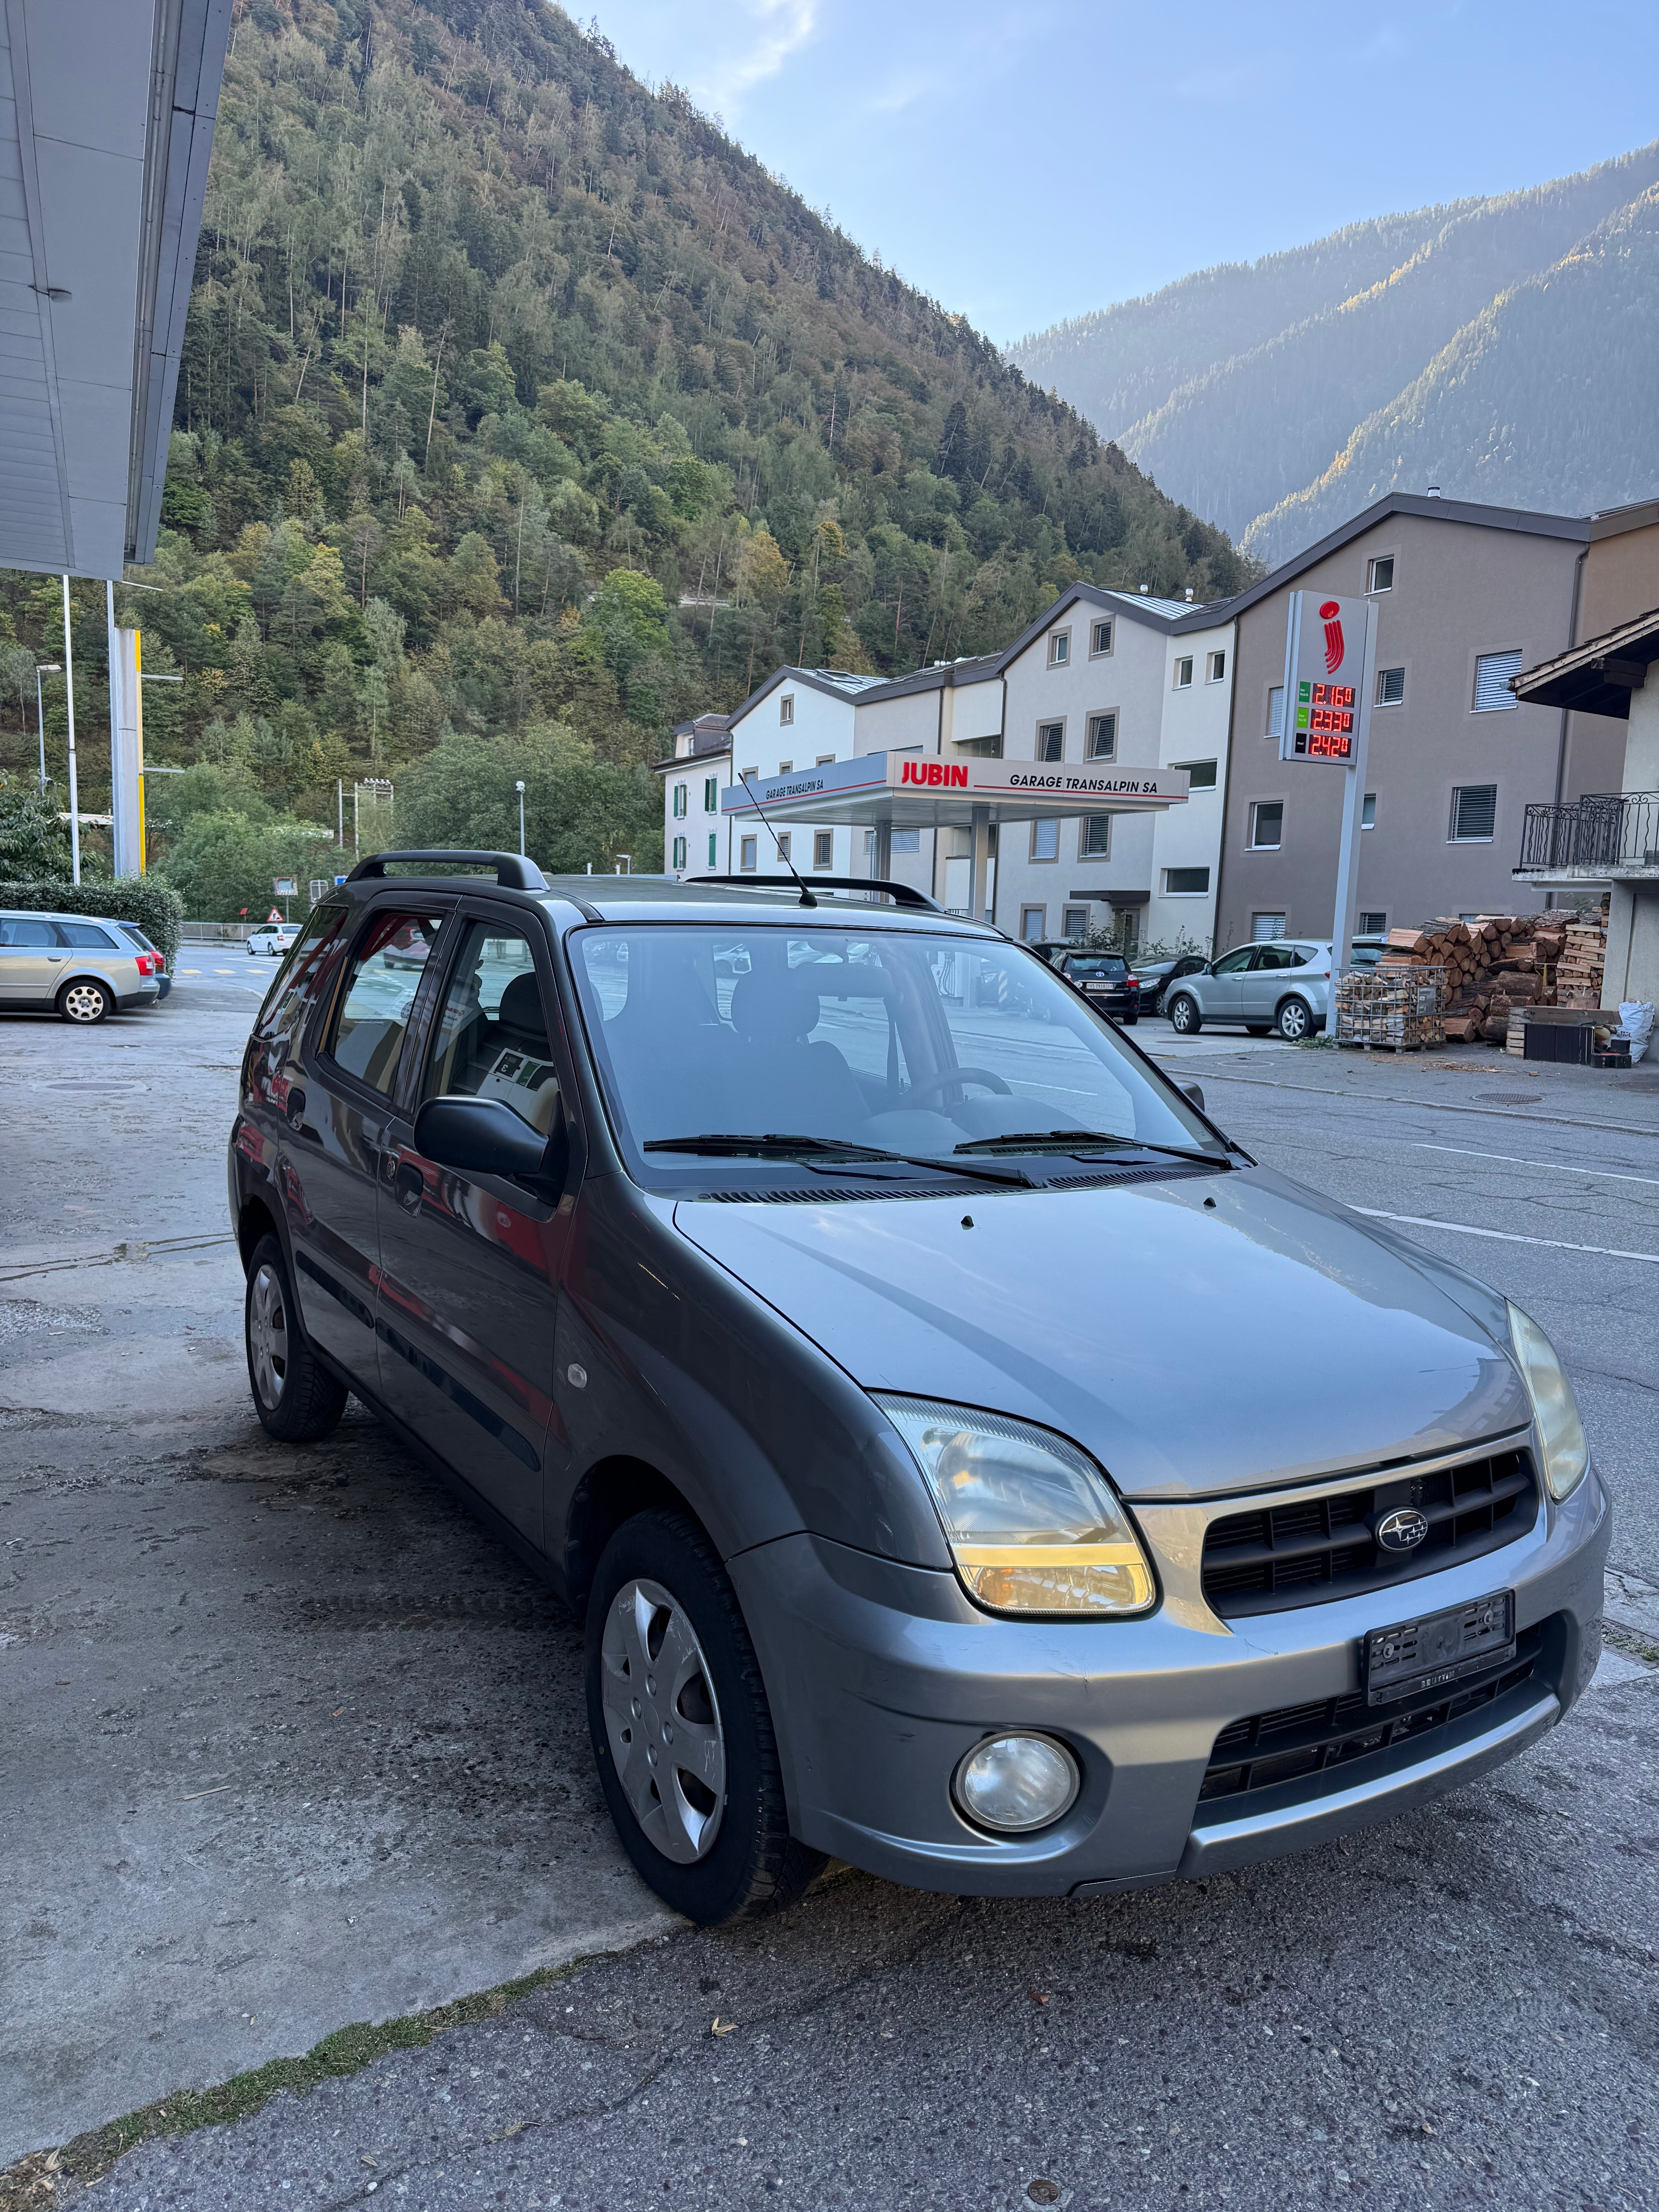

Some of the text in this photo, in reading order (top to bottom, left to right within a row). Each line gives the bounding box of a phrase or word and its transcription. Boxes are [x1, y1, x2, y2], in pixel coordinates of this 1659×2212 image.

[902, 762, 968, 787] JUBIN
[1010, 775, 1158, 793] GARAGE TRANSALPIN SA
[766, 779, 823, 800] GARAGE TRANSALPIN SA
